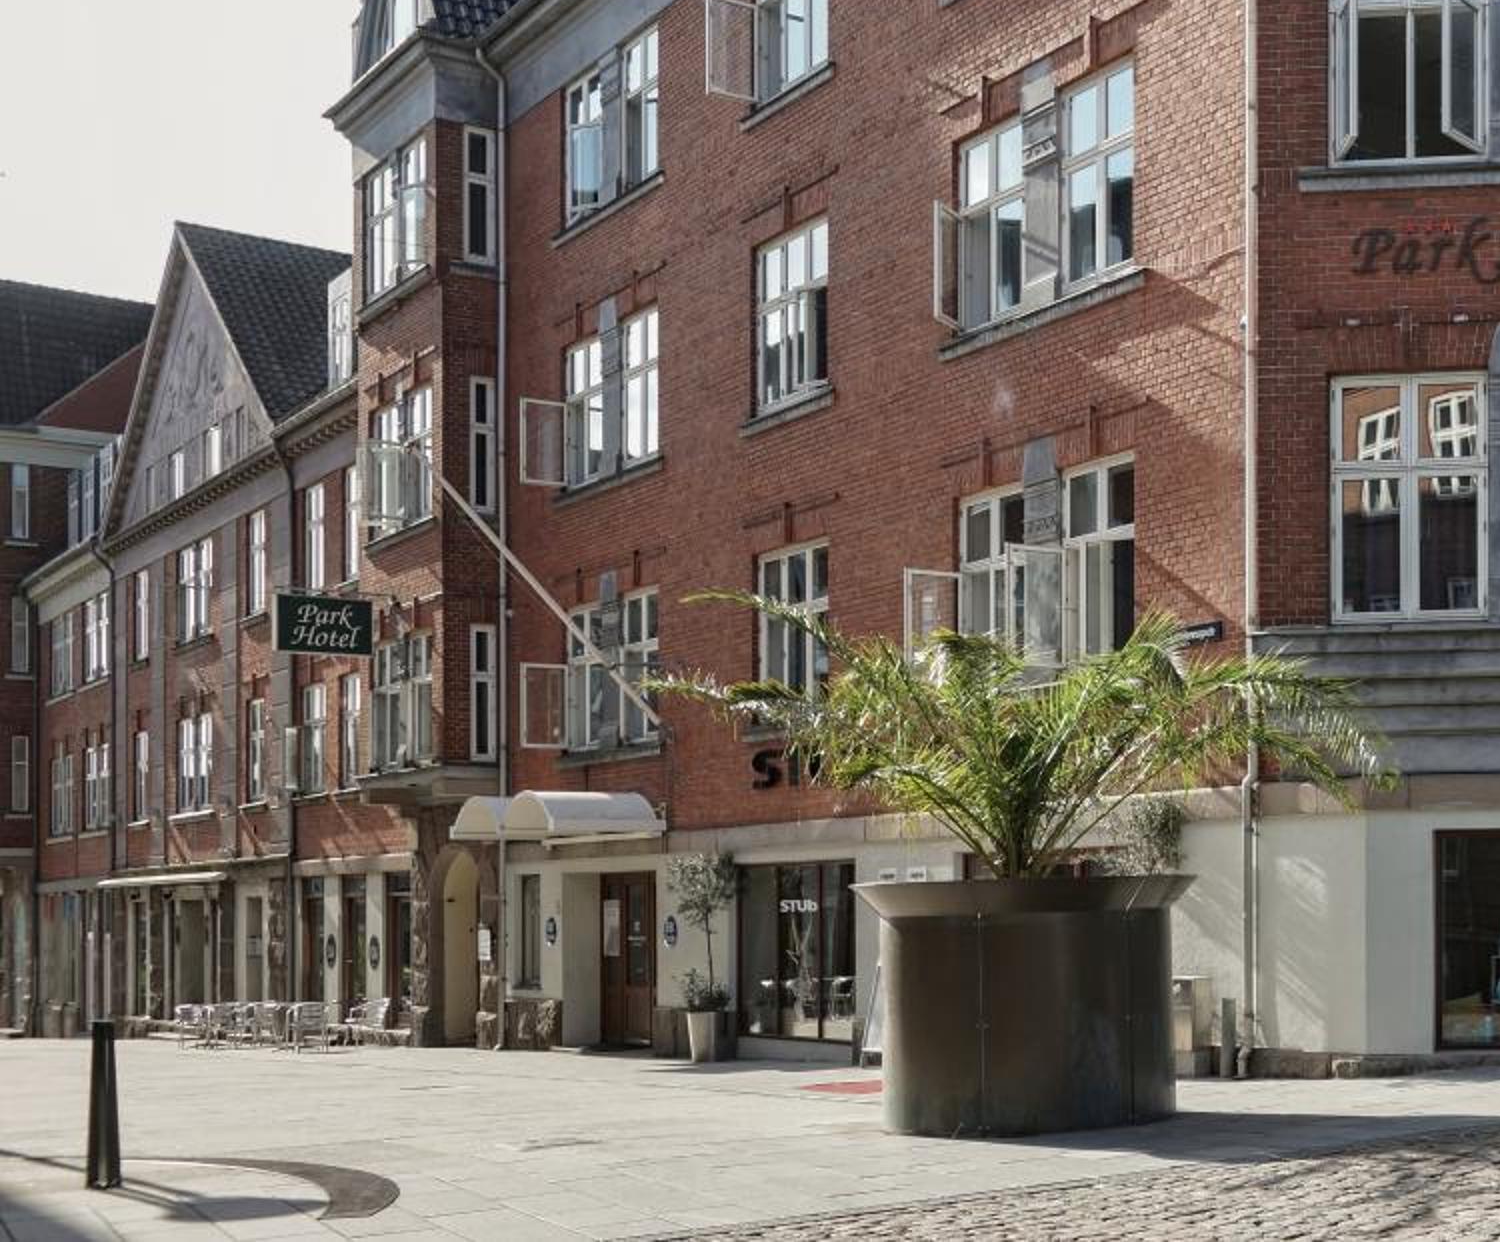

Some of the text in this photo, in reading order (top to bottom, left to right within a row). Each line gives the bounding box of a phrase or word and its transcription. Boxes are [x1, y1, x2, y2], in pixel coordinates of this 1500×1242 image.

[1351, 216, 1500, 284] Park
[297, 604, 356, 629] Park
[290, 625, 362, 650] Hotel
